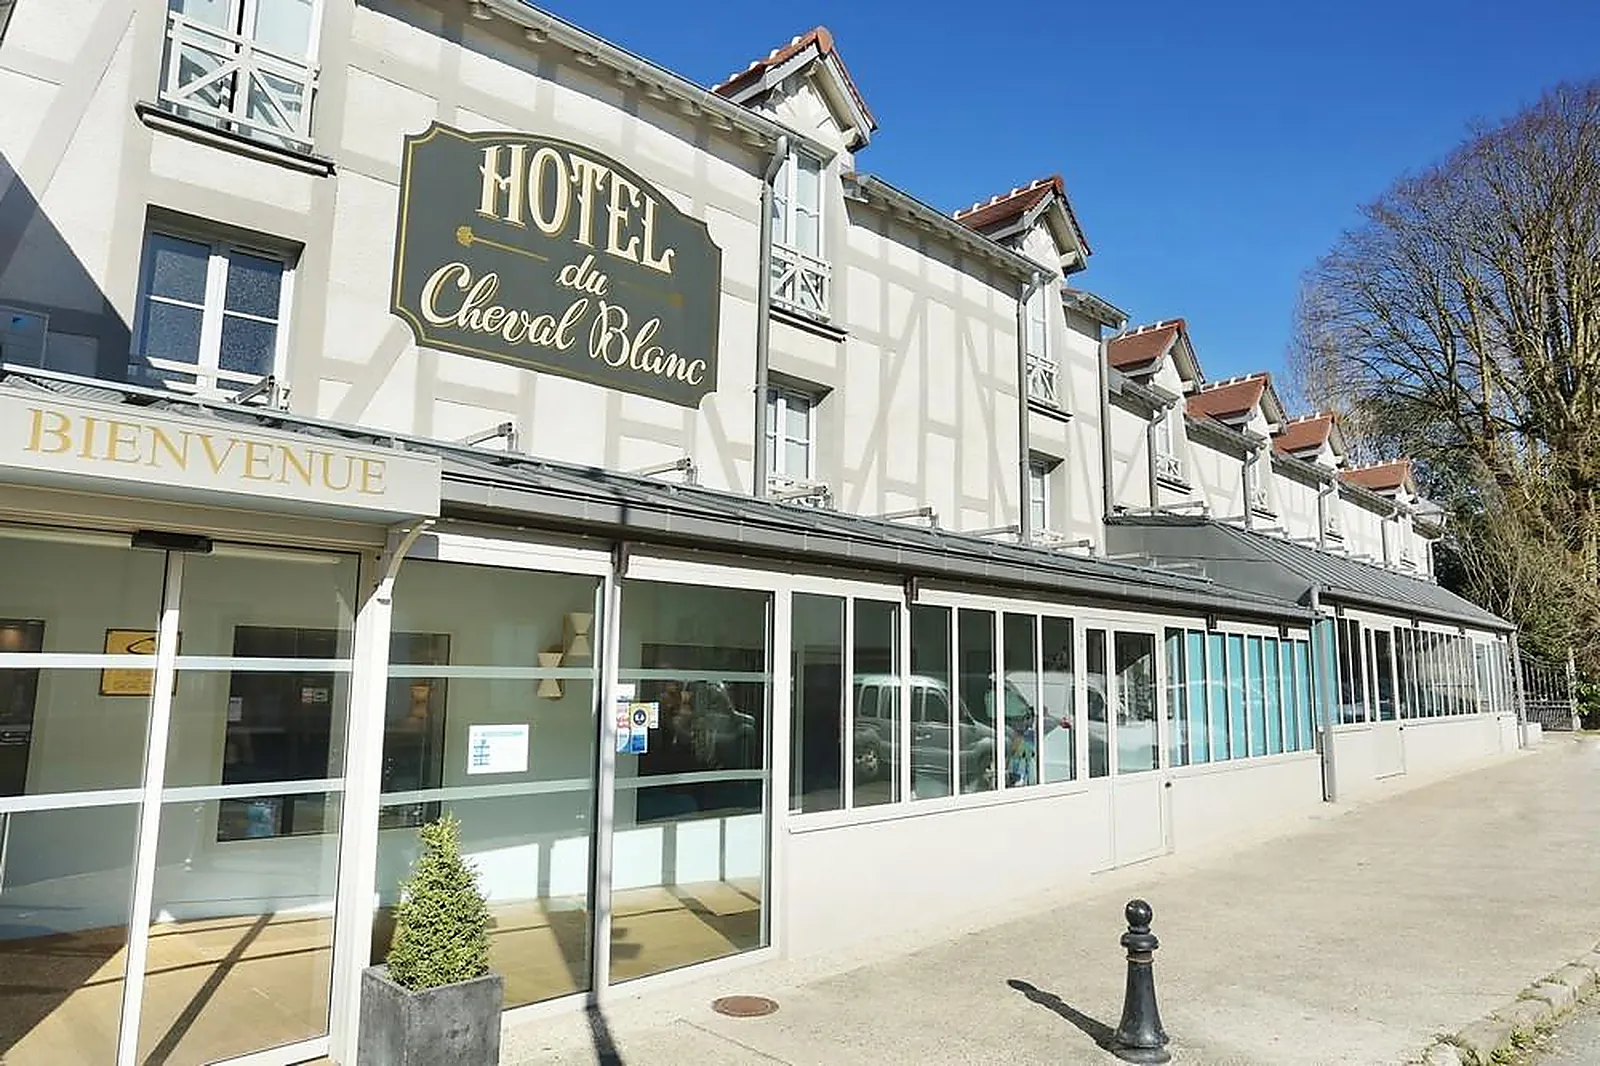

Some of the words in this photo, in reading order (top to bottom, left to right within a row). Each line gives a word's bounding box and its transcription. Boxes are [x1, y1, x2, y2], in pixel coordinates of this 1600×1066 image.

[476, 143, 675, 274] HOTEL
[420, 262, 589, 350] Cheval
[589, 299, 706, 385] Blanc
[556, 254, 607, 296] du
[23, 408, 388, 495] BIENVENUE
